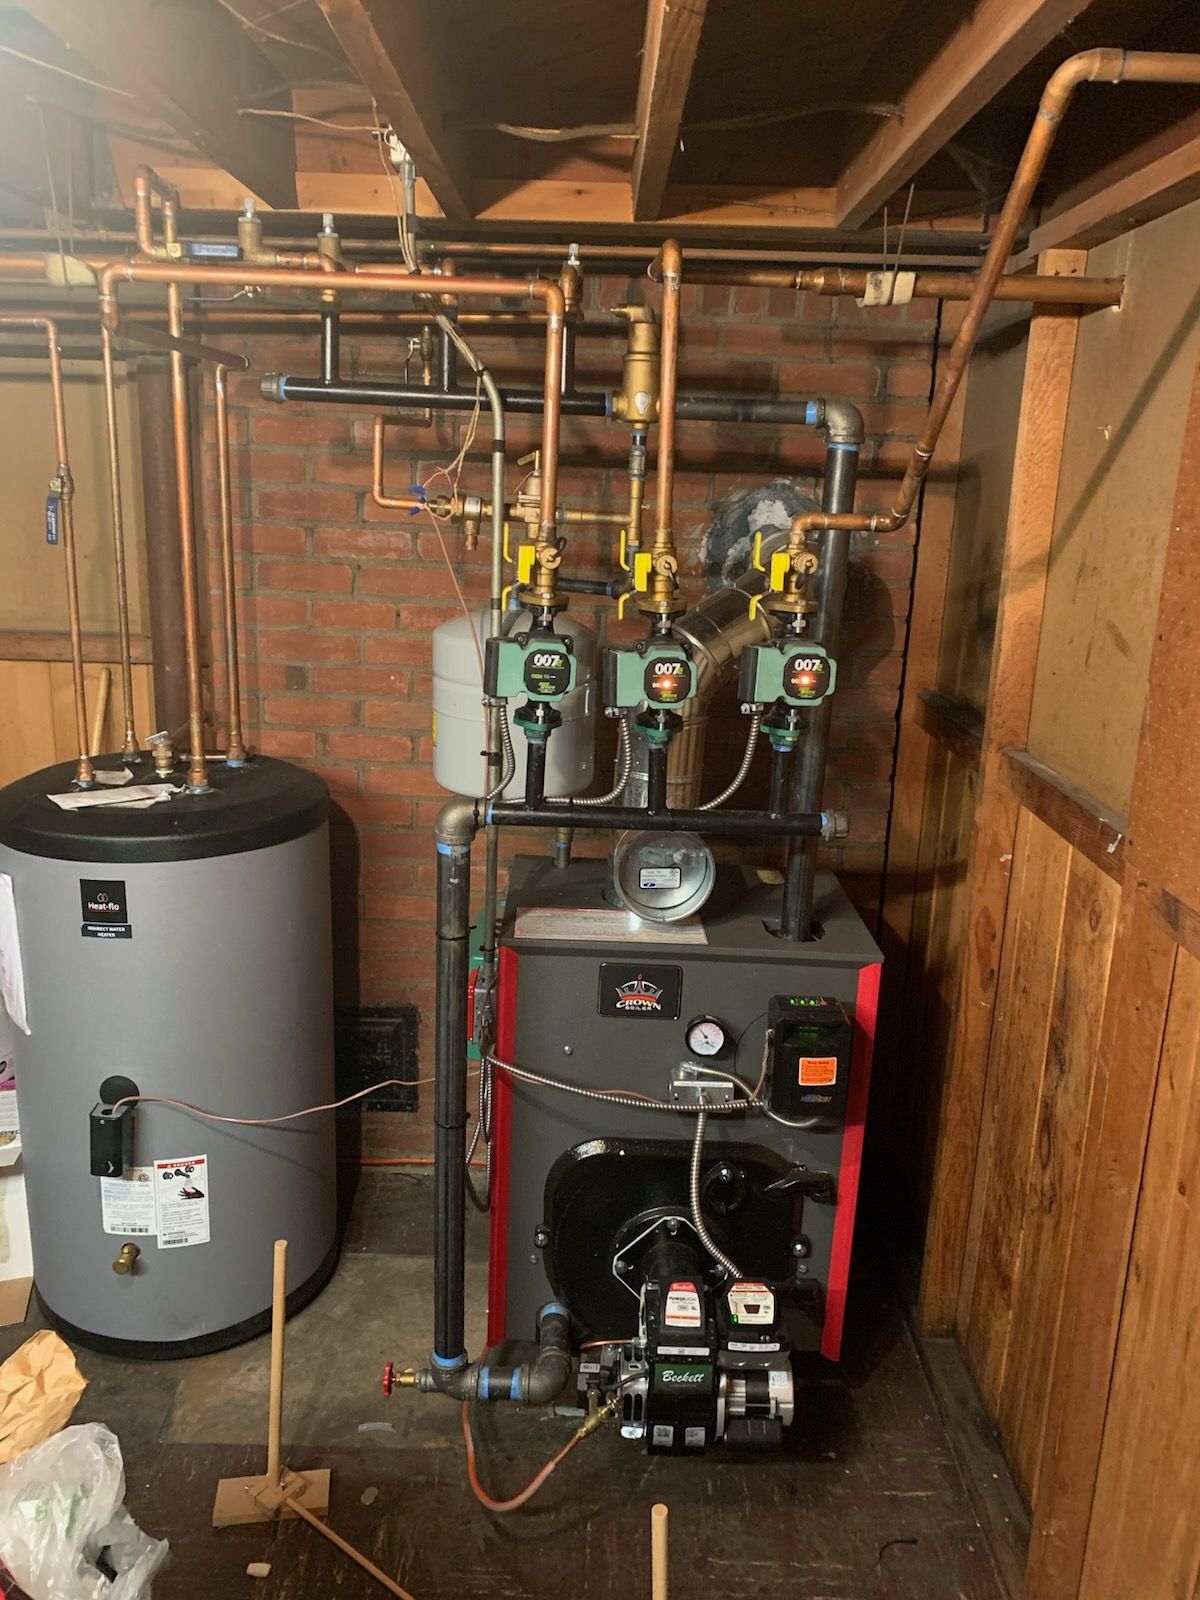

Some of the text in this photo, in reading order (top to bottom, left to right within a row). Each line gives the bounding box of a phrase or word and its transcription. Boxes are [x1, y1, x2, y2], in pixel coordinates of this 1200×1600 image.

[87, 901, 120, 911] Heat-flo
[615, 999, 661, 1011] CROWN
[662, 1369, 705, 1383] Beckett
